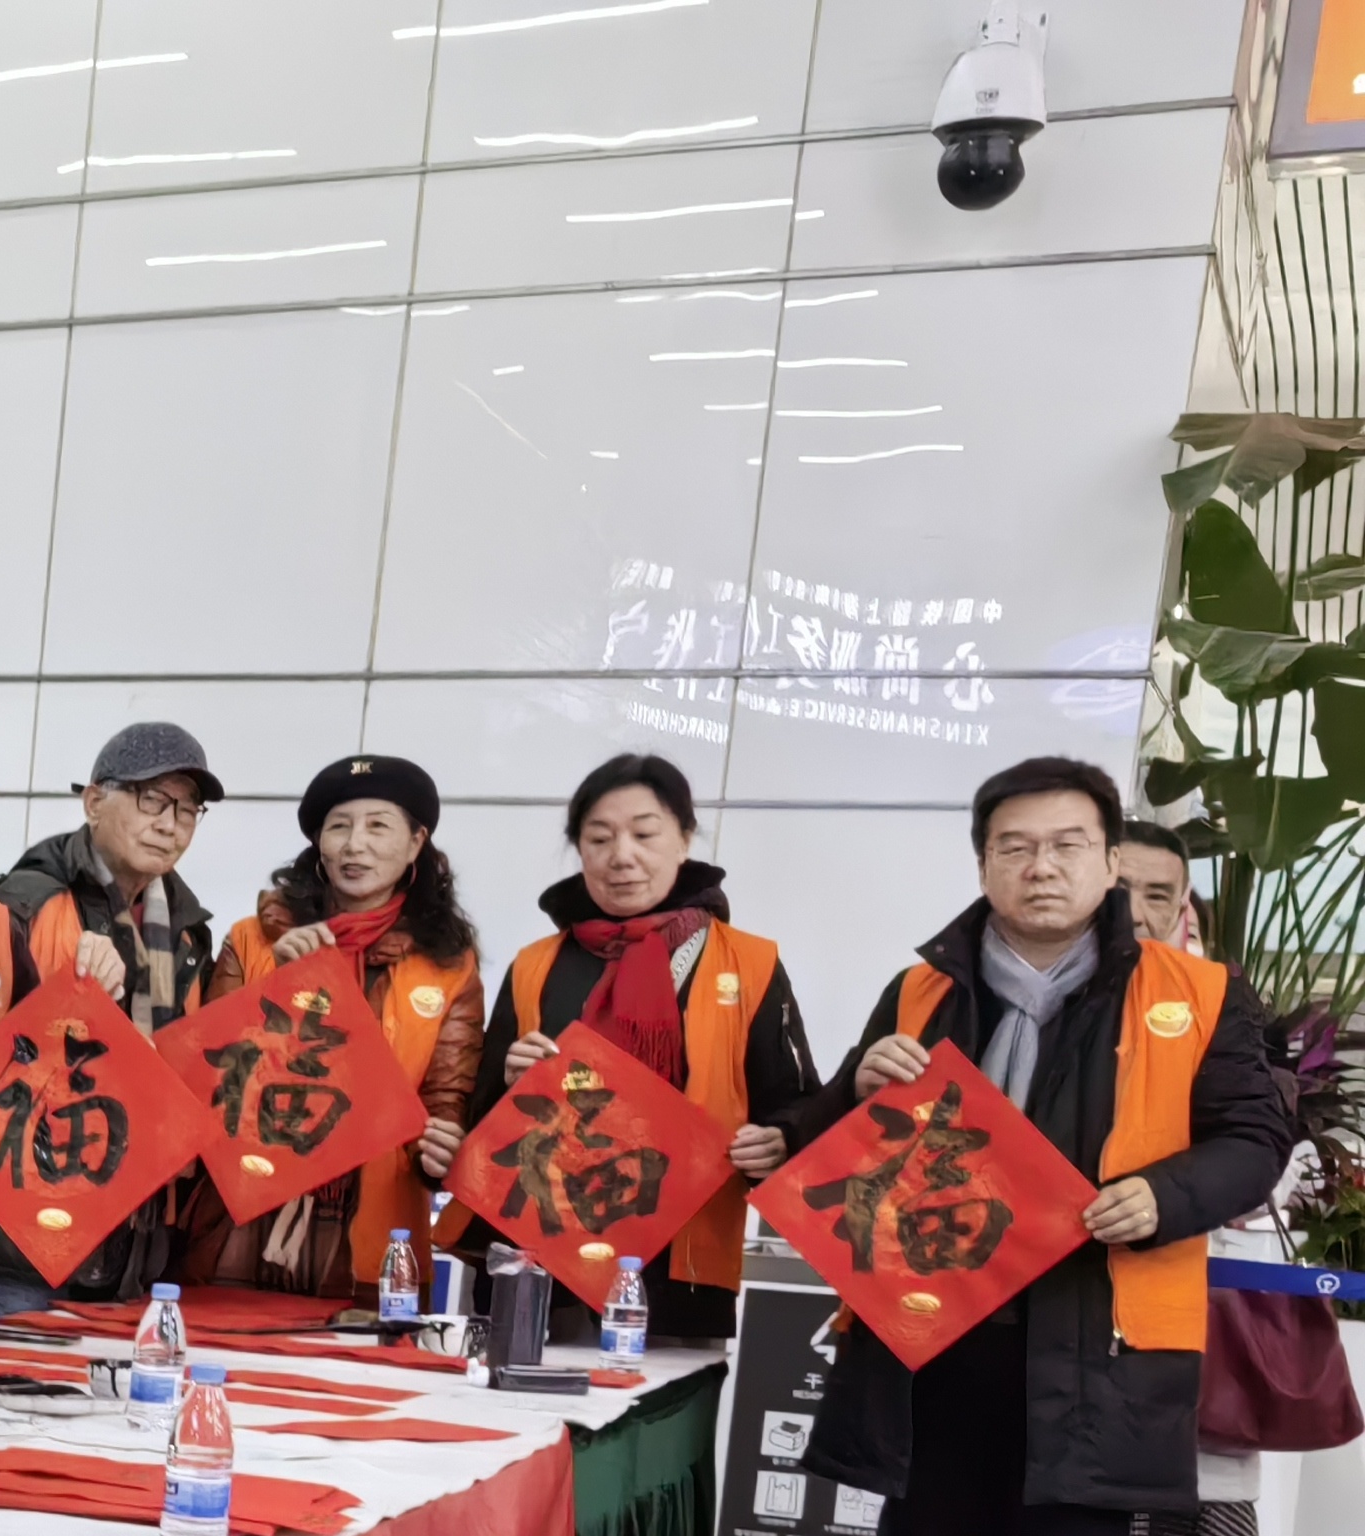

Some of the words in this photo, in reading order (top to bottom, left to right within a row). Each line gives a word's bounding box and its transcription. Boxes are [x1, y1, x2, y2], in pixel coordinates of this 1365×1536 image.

[204, 994, 352, 1157] 福
[491, 1057, 670, 1238] 福
[801, 1079, 1015, 1277] 福
